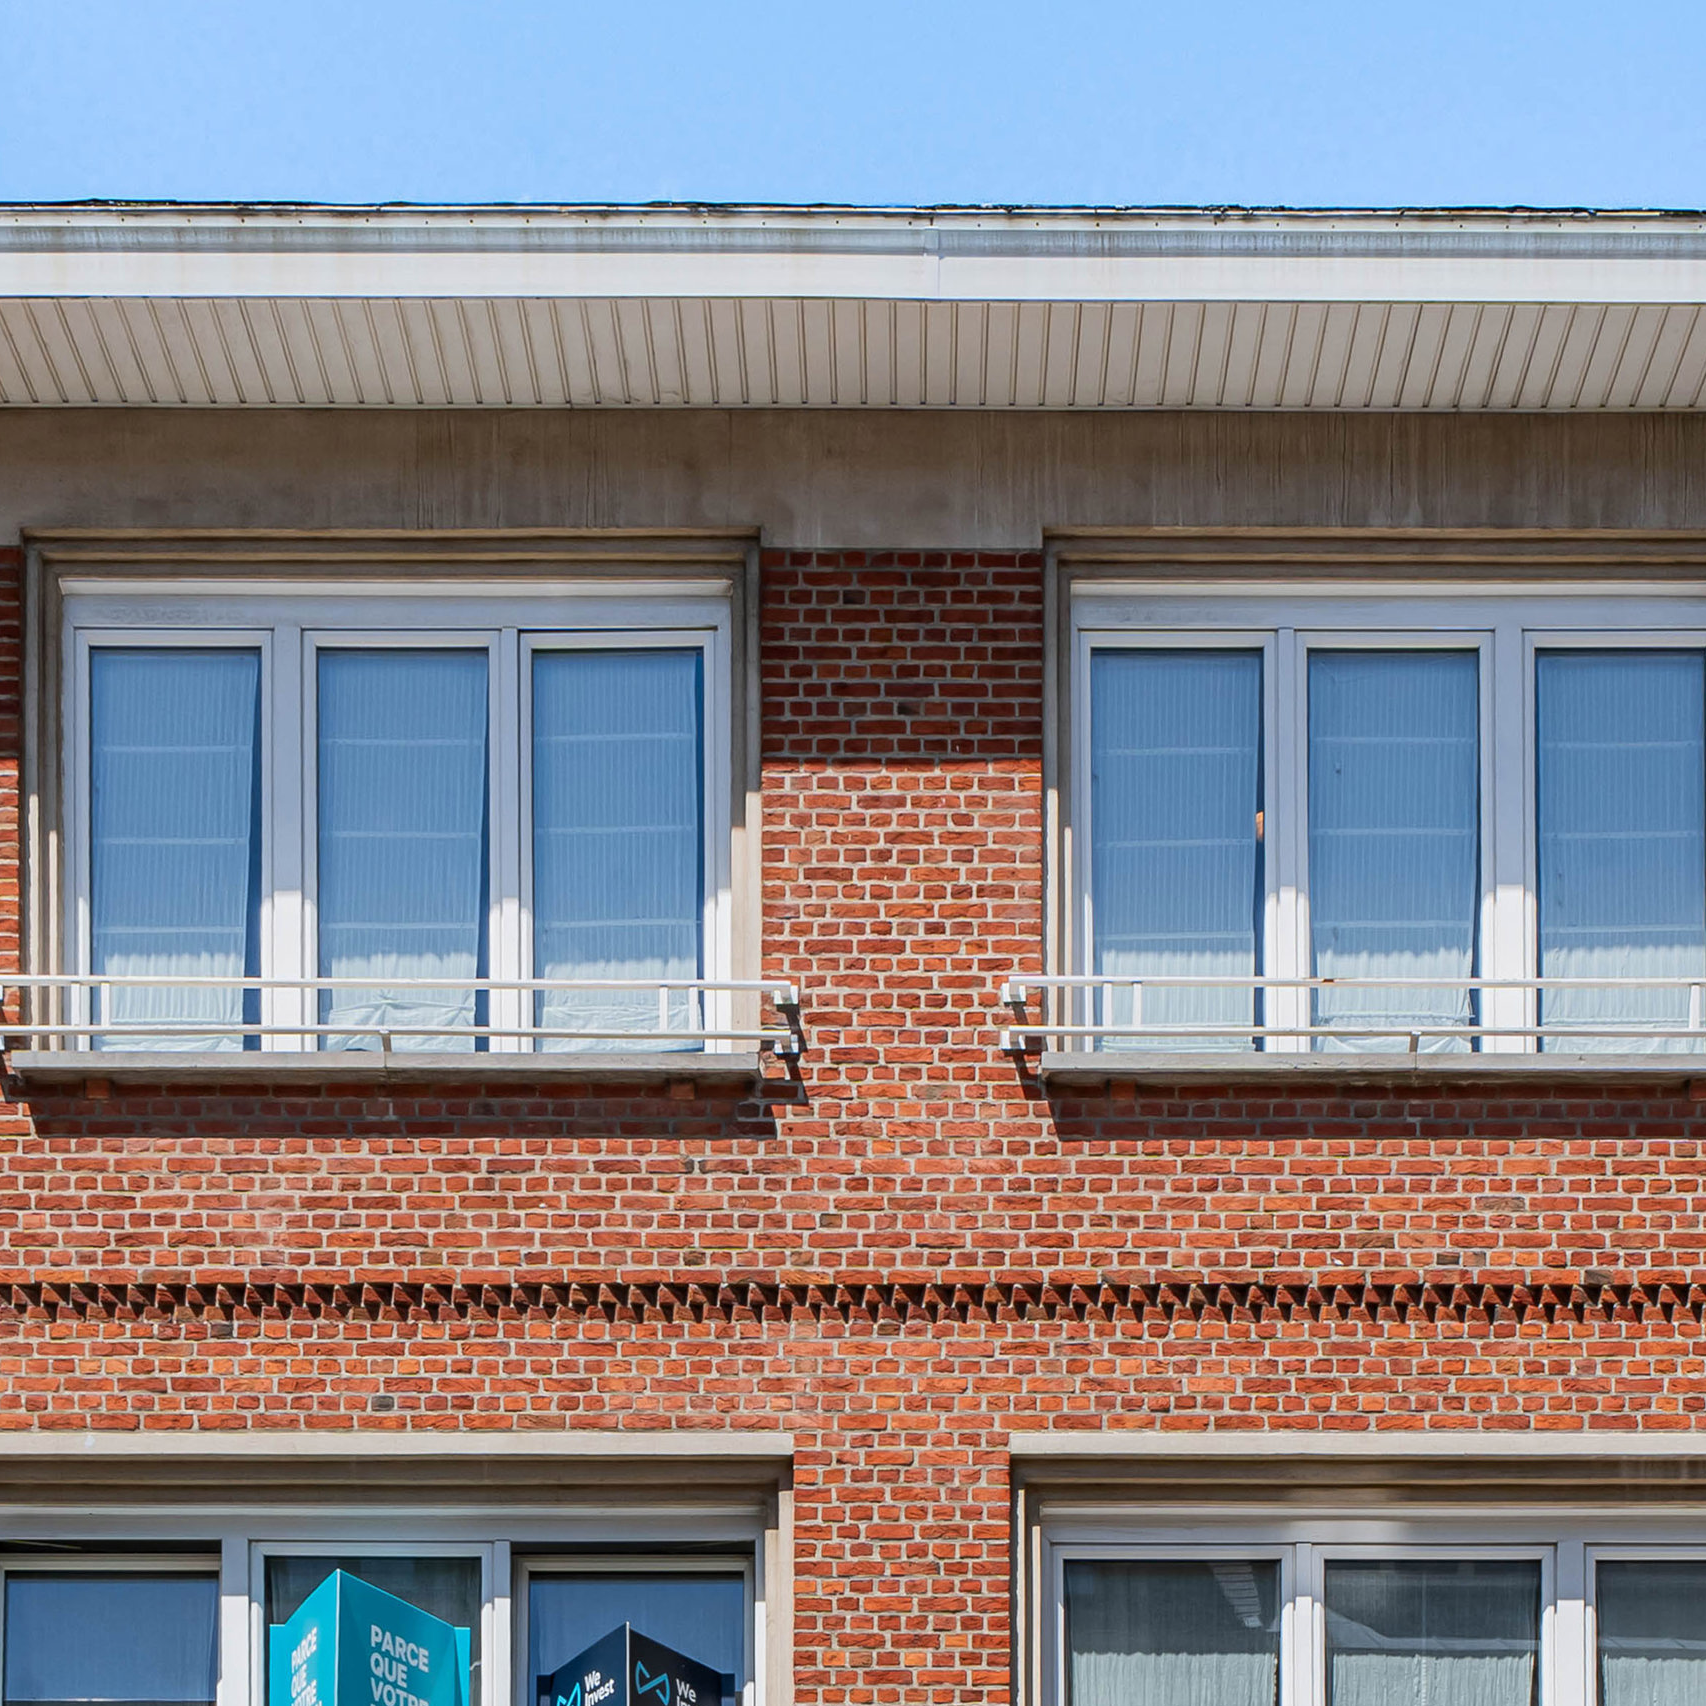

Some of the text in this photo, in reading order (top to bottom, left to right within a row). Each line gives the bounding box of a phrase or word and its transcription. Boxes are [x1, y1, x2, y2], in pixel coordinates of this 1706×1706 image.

[291, 1626, 318, 1674] PARCE
[370, 1624, 430, 1673] PARCE
[370, 1652, 408, 1688] QUE
[584, 1670, 601, 1691] We
[676, 1678, 697, 1703] We
